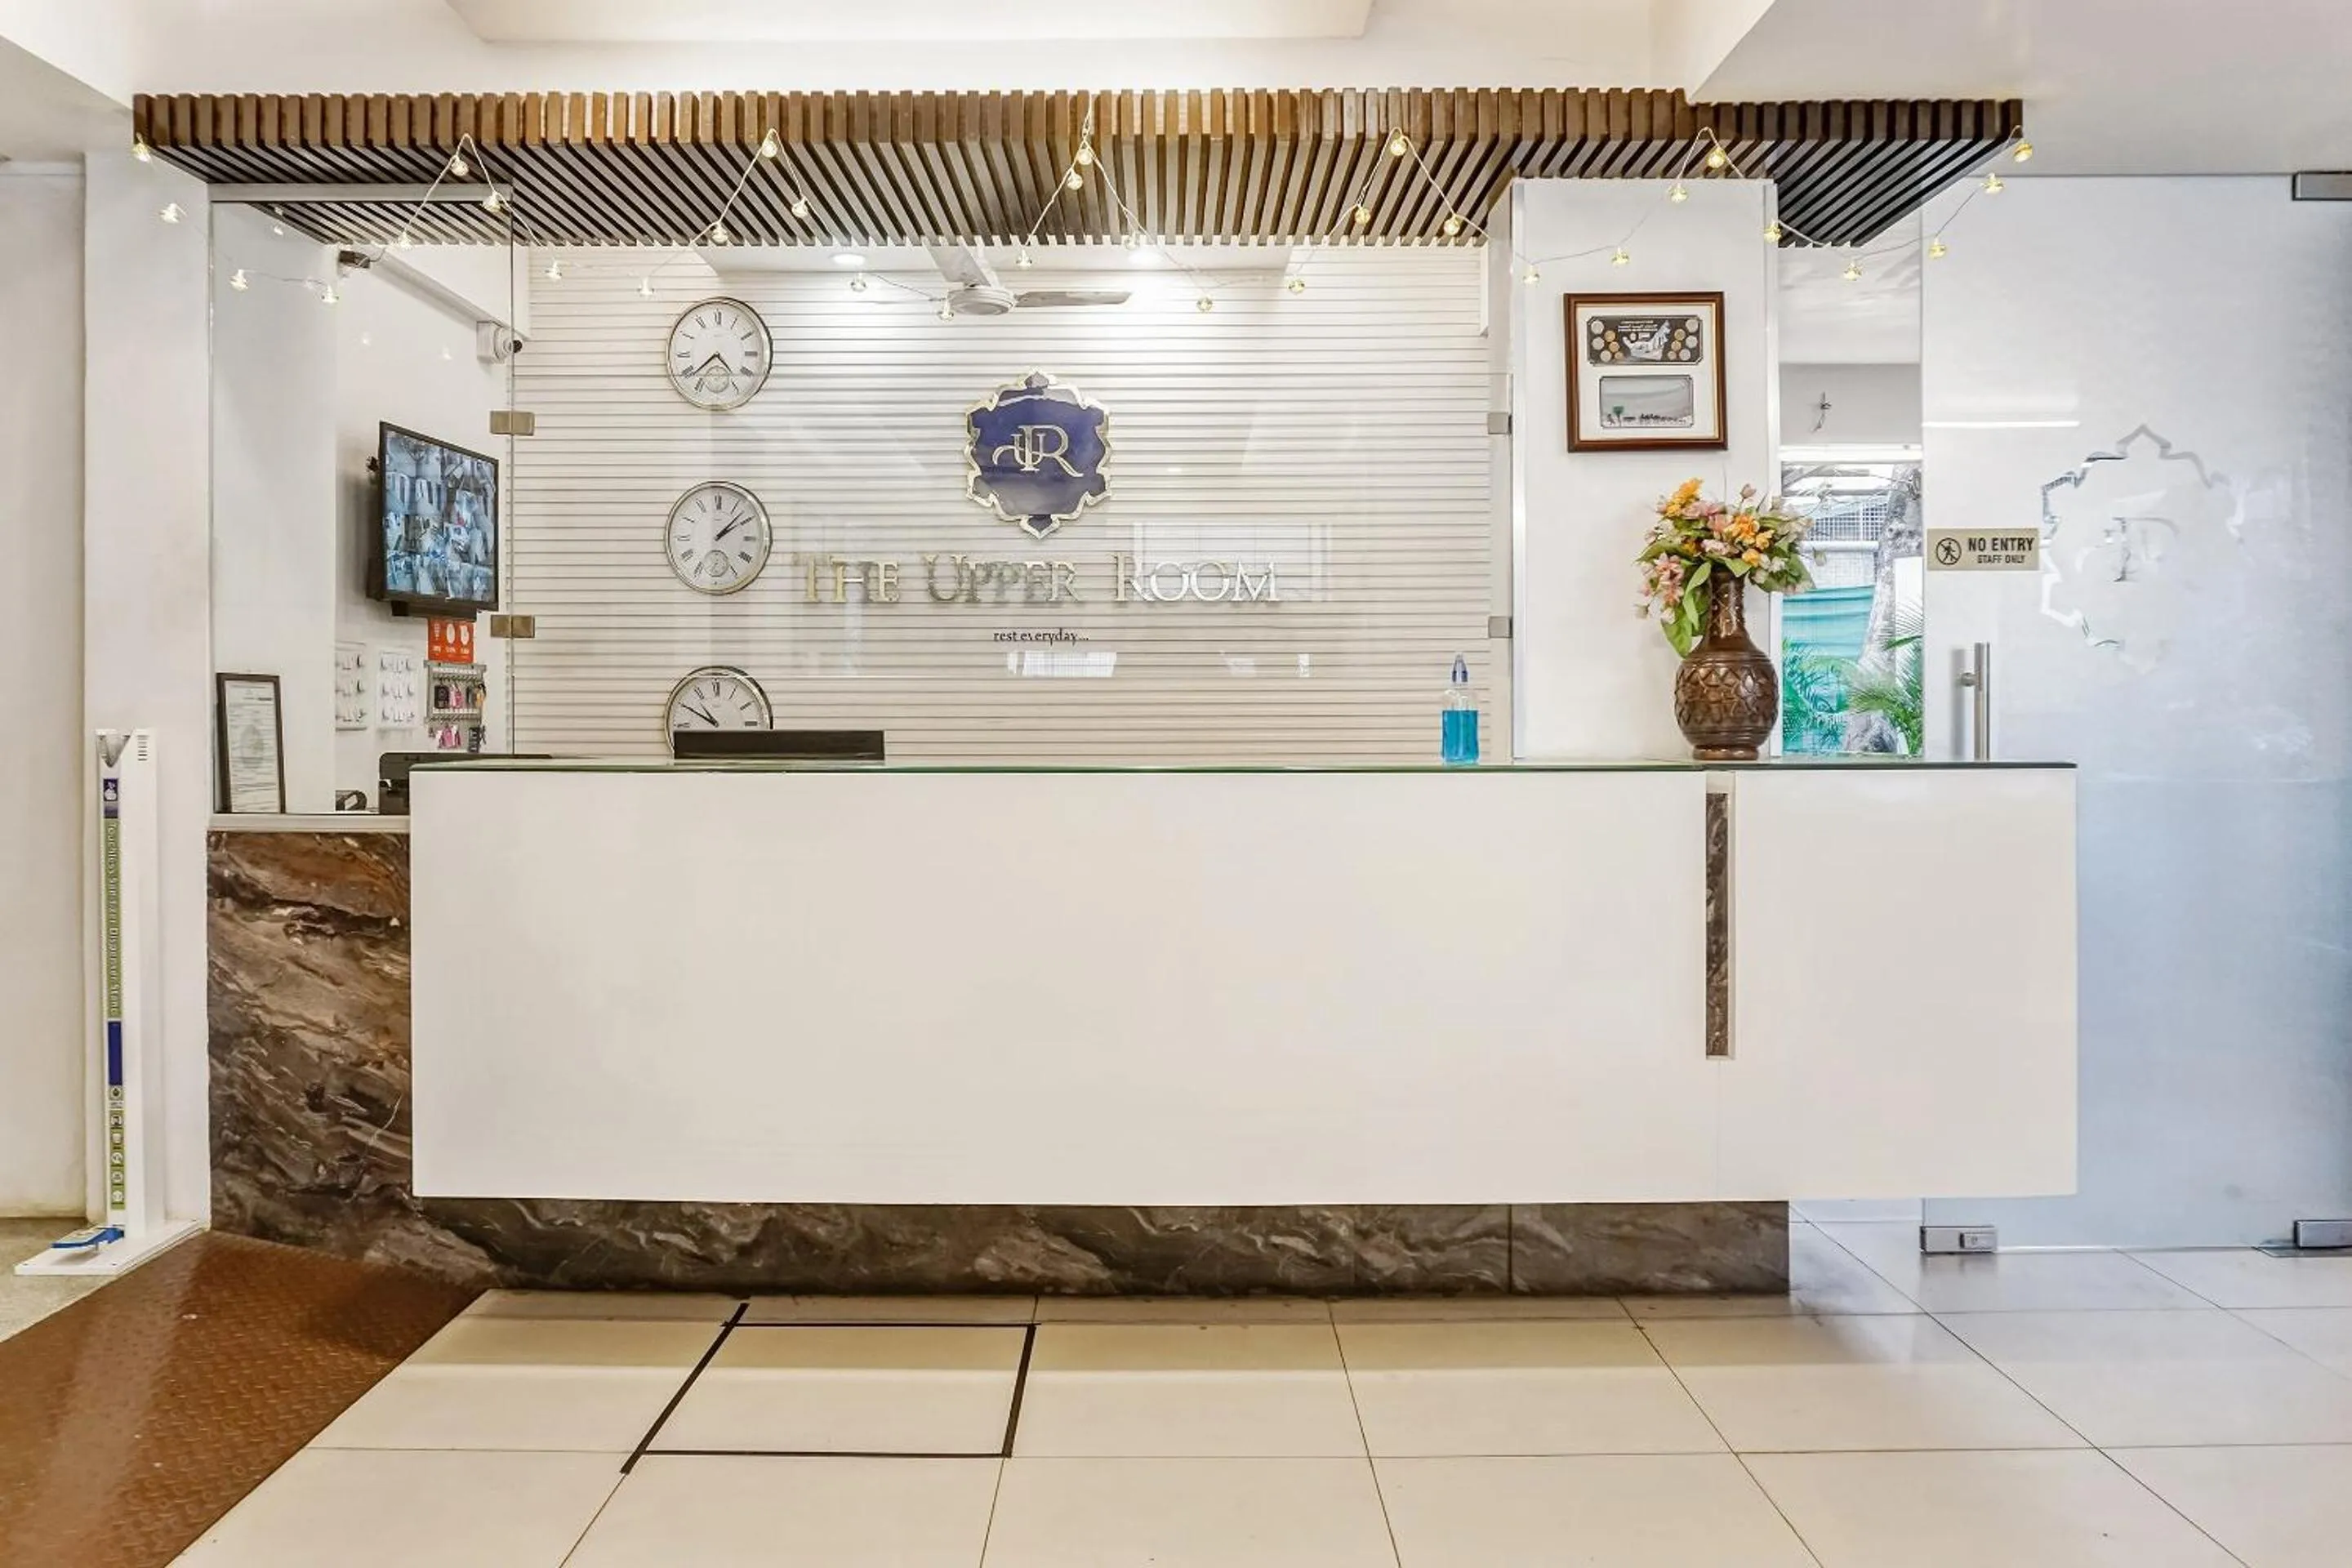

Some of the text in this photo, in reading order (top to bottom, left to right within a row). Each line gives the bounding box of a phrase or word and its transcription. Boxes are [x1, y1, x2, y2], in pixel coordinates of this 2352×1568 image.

[1968, 537, 2035, 551] NO ENTRY
[1977, 555, 2026, 564] STAFF ONLY
[794, 551, 1282, 604] THE UPPER ROOM
[993, 630, 1018, 642] rest
